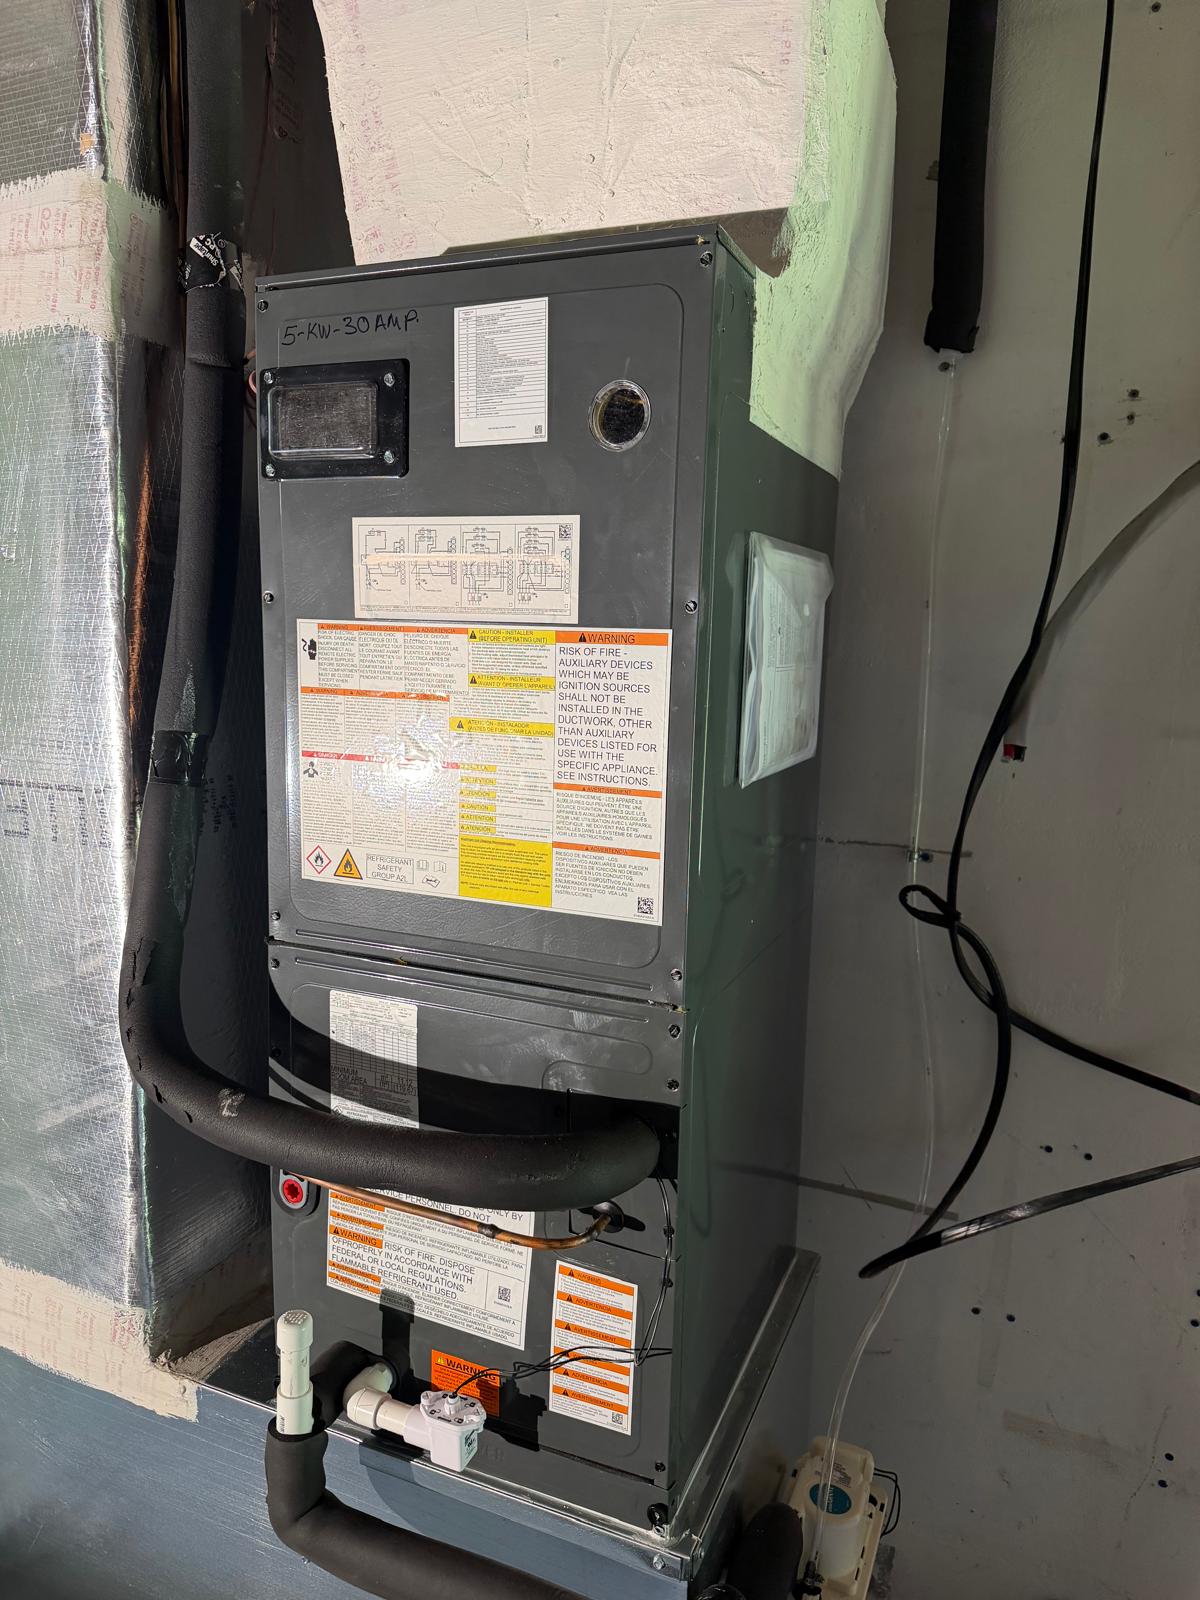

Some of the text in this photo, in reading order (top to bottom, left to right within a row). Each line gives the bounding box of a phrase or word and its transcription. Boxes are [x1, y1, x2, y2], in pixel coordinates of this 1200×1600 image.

[588, 633, 635, 644] WARNING
[560, 647, 621, 656] RISK OF FIRE
[559, 659, 653, 670] AUXILIARY DEVICES
[559, 670, 629, 680] WHICH MAY BE
[559, 681, 650, 693] IGNITION SOURCES
[559, 692, 625, 703] SHALL NOT BE
[558, 704, 609, 714] INSTALLED
[624, 707, 643, 716] THE
[558, 715, 652, 729] DUCTWORK, OTHER
[558, 727, 634, 739] THAN AUXILIARY
[558, 738, 657, 752] DEVICES LISTED FOR
[557, 750, 625, 761] USE WITH THE
[557, 760, 658, 775] SPECIFIC APPLIANCE.
[557, 771, 650, 787] SEE INSTRUCTIONS.
[368, 855, 412, 866] REFRIGERANT
[371, 871, 395, 879] GROUP
[377, 864, 402, 872] SAFETY
[459, 1208, 471, 1217] DO
[473, 1212, 490, 1222] NOT
[341, 1228, 377, 1246] WARNING
[332, 1236, 473, 1284] OFPROPERLY IN ACCORDANCE WITH
[384, 1242, 403, 1253] RISK
[404, 1248, 415, 1256] OF
[440, 1258, 475, 1275] DISPOSE
[332, 1245, 466, 1293] FEDERAL OR LOCAL REGULATIONS.
[332, 1254, 376, 1274] FLAMMABLE
[377, 1268, 433, 1292] REFRIGERANT
[576, 1297, 612, 1313] ADVERTENCIA
[574, 1326, 617, 1343] AVERTISSEMENT
[572, 1372, 608, 1387] ADVERTENCIA
[572, 1391, 614, 1409] AVERTISSEMENT
